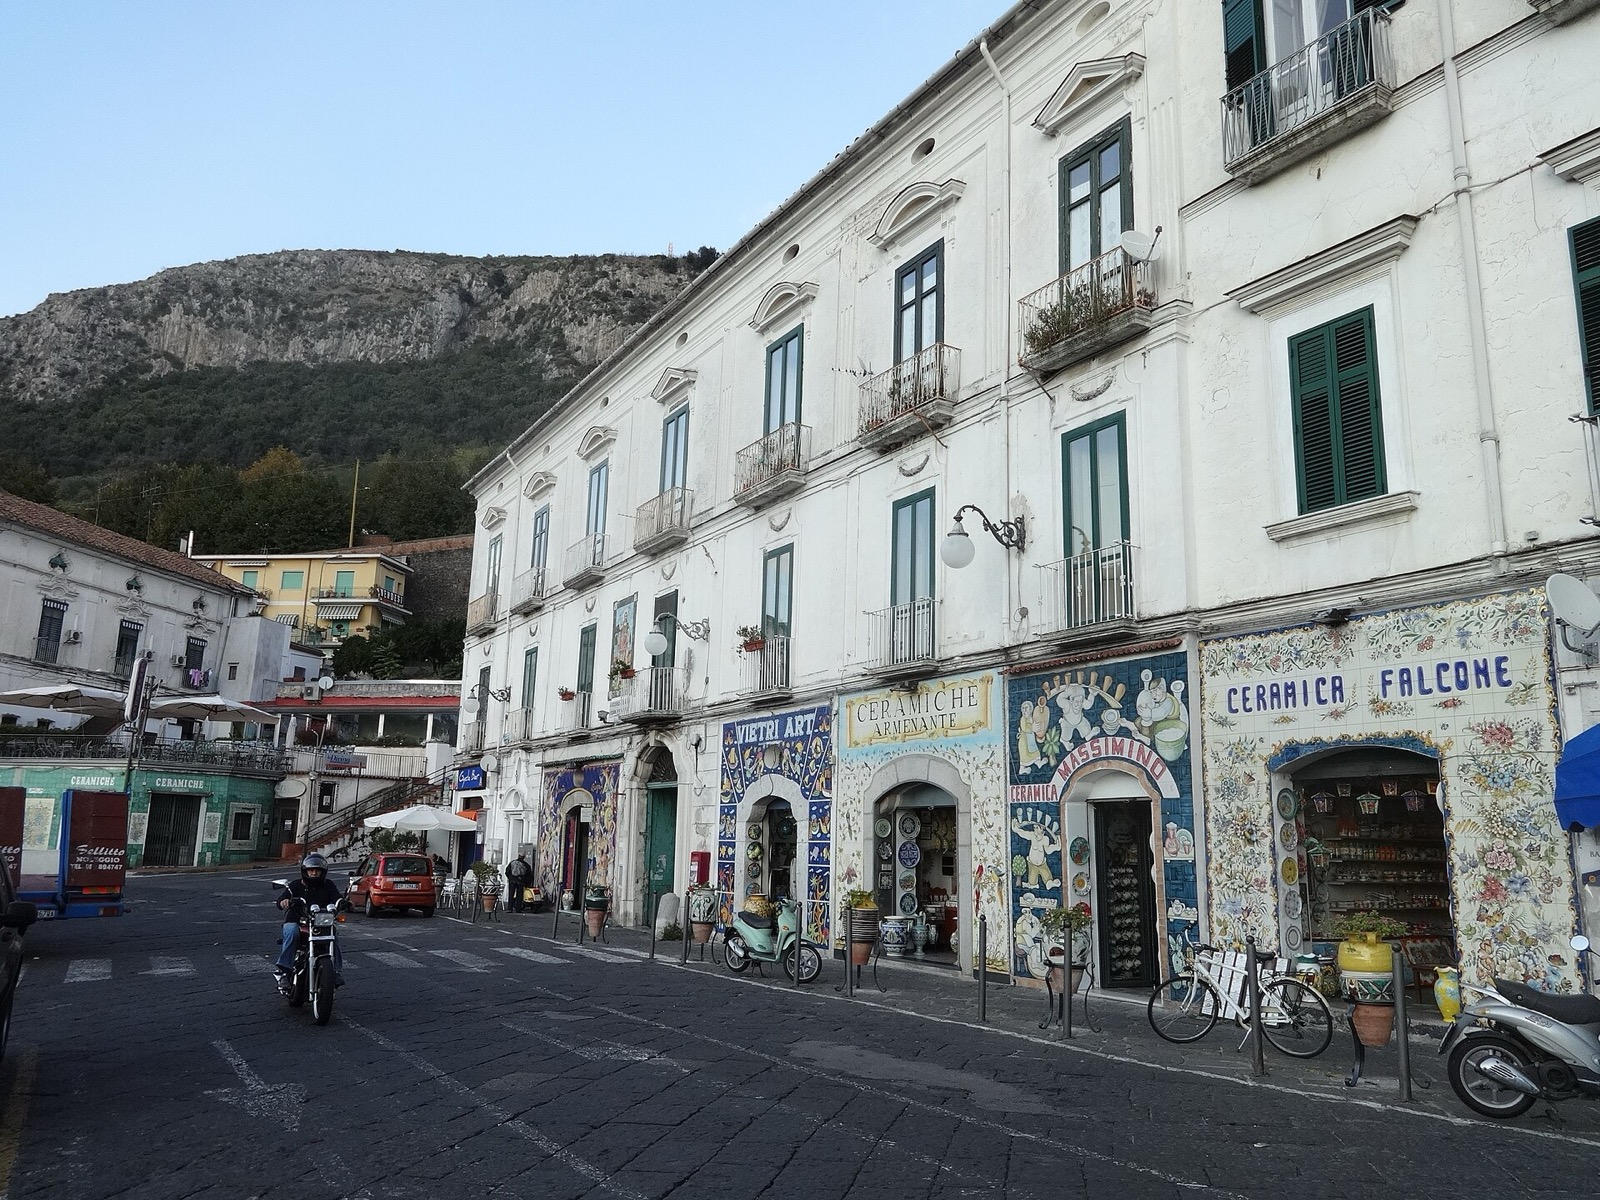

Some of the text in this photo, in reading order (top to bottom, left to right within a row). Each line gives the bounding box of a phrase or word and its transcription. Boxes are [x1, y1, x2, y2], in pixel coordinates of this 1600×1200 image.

[1227, 655, 1513, 714] CERAMICA FALCONE
[857, 685, 979, 723] CERAMICHE
[737, 713, 816, 744] VIETRI ART
[873, 713, 957, 736] ARMENANTE
[1058, 737, 1167, 781] MASSIMINO
[71, 776, 116, 786] CERAMICHE
[155, 777, 204, 789] CERAMICHE
[1010, 784, 1058, 803] CERAMICA
